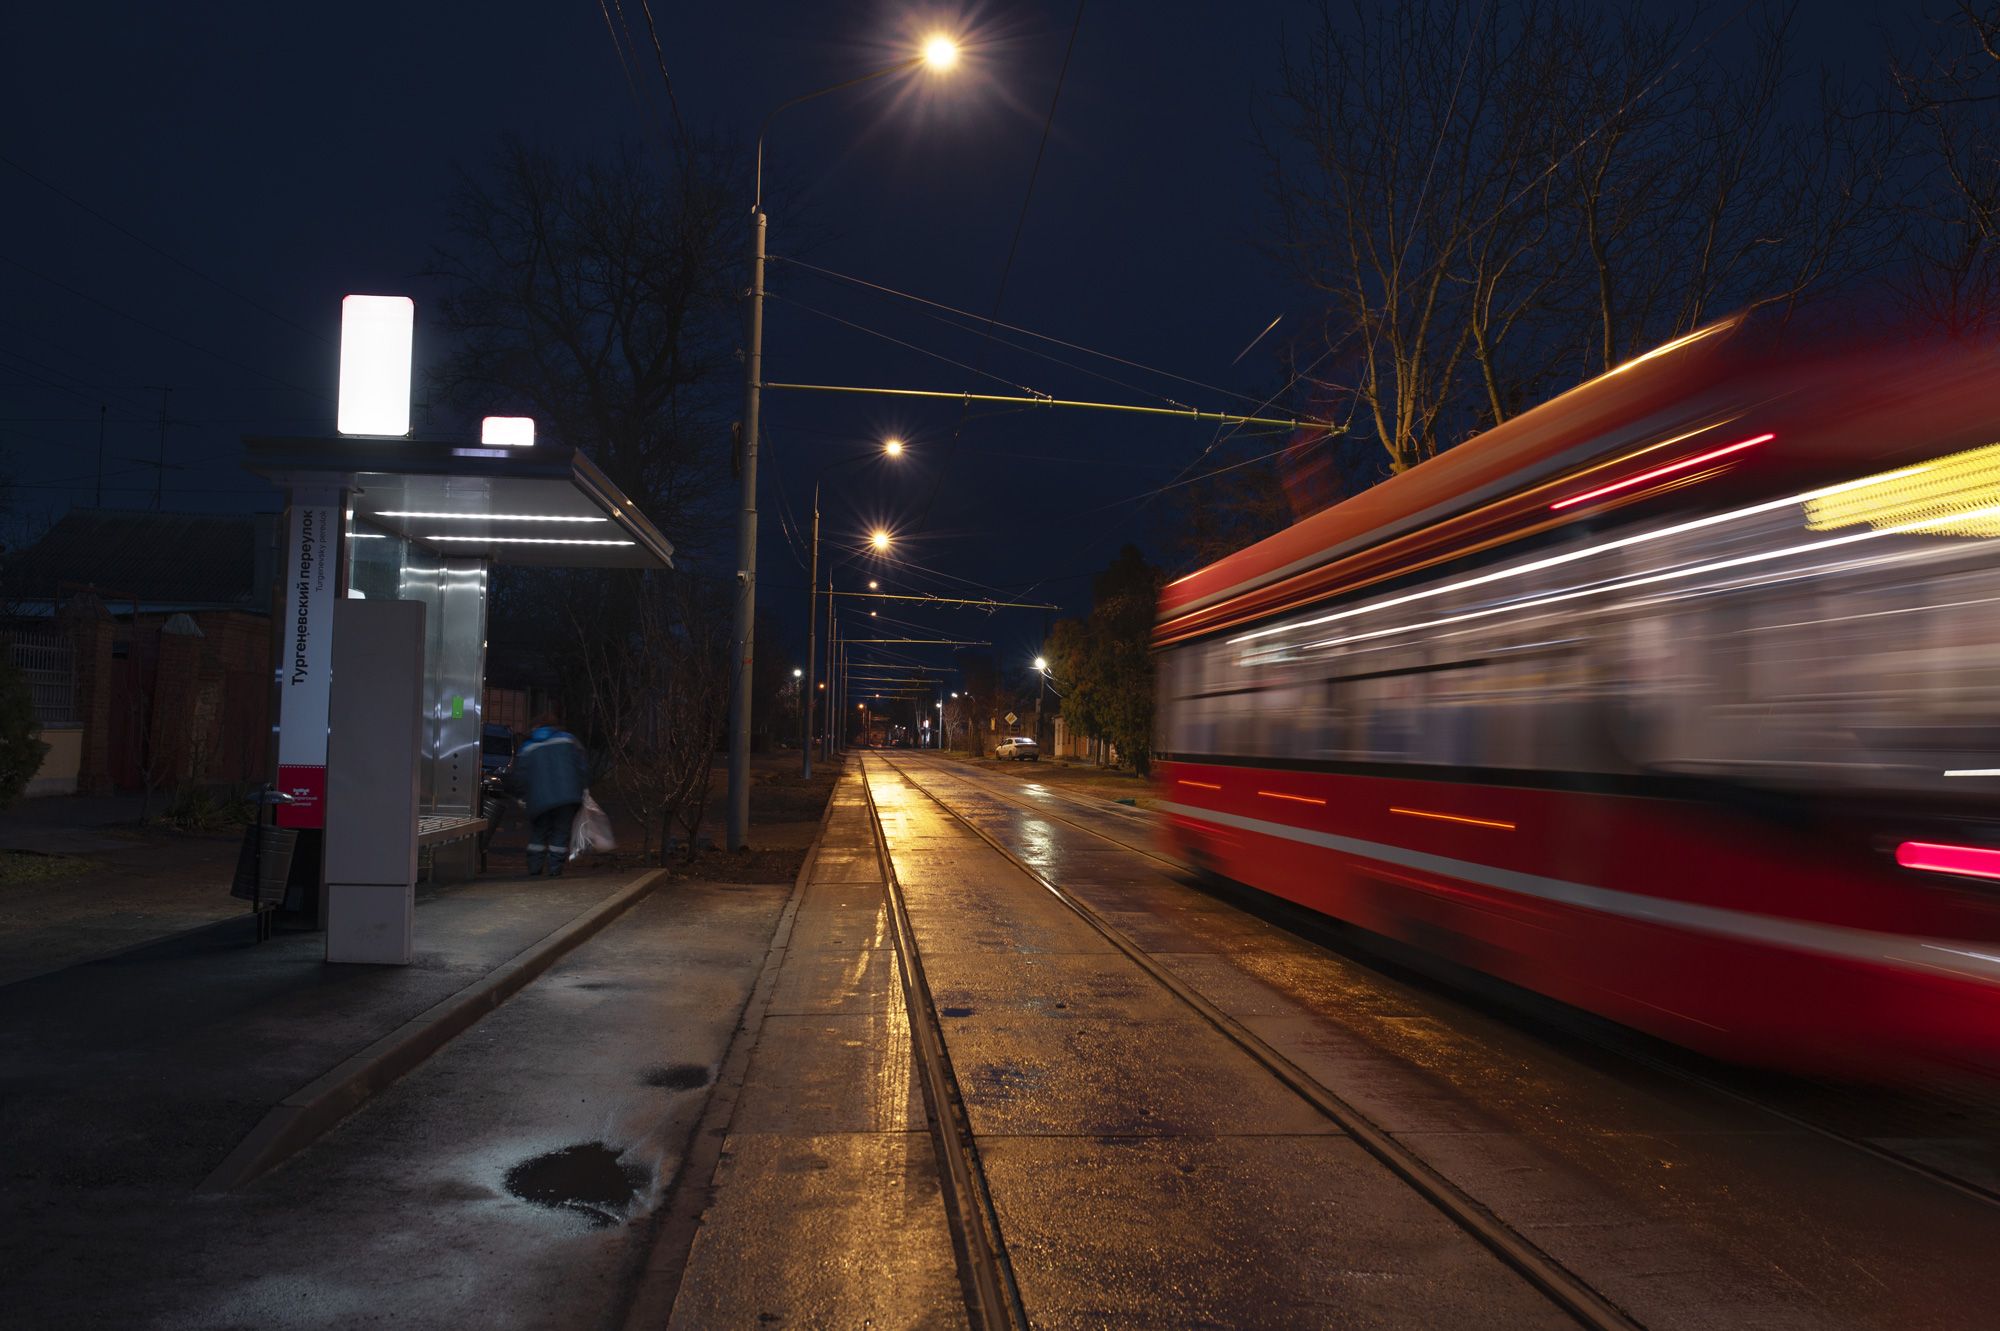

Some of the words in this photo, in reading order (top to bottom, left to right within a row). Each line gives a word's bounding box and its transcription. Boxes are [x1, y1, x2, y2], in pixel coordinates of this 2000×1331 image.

[319, 511, 328, 543] pereulok
[316, 545, 327, 592] Turgenevsky
[292, 582, 309, 685] Тургеневский
[301, 510, 315, 579] переулок
